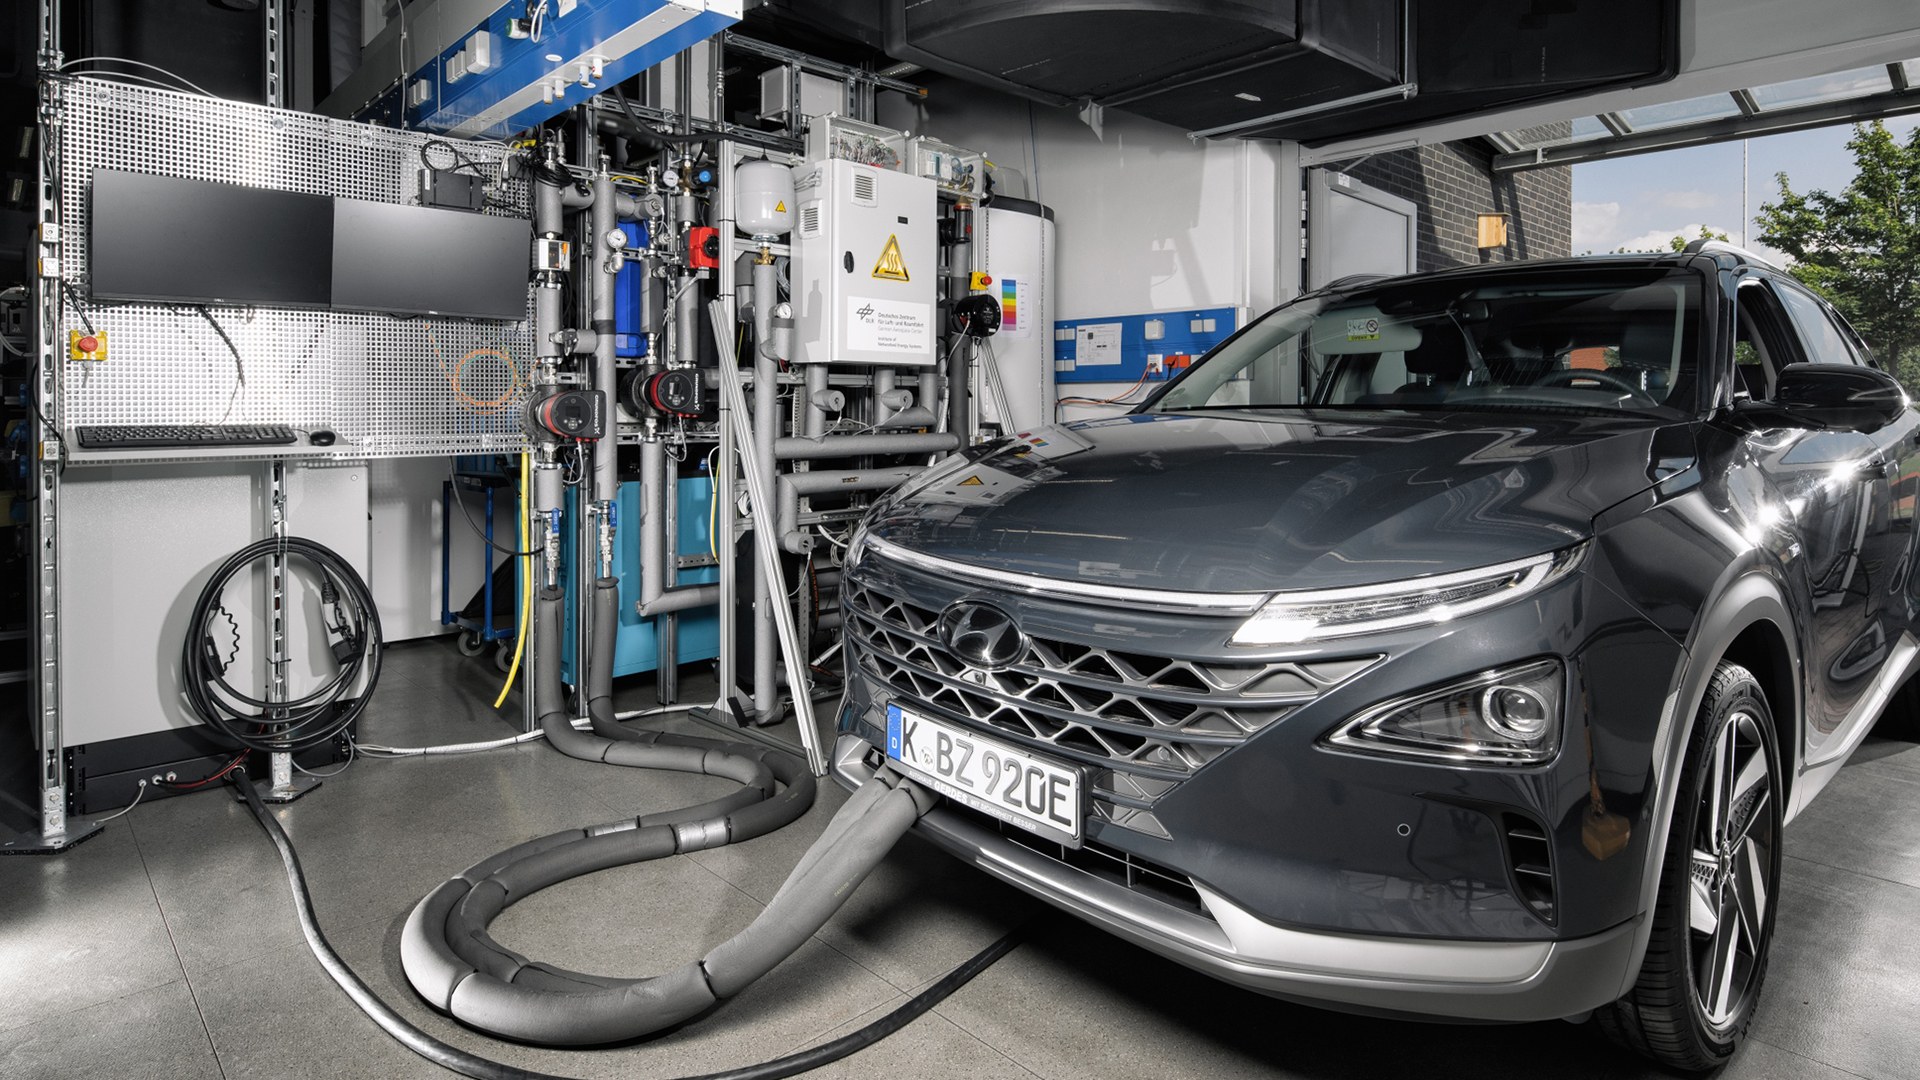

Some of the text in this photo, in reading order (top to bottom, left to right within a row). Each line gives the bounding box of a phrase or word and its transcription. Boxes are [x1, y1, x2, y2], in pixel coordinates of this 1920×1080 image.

[891, 736, 898, 749] D
[902, 716, 919, 763] K
[936, 730, 974, 788] BZ
[908, 770, 1037, 832] AUTOHAUS GERDES MIT SICHERHEIT BESSER
